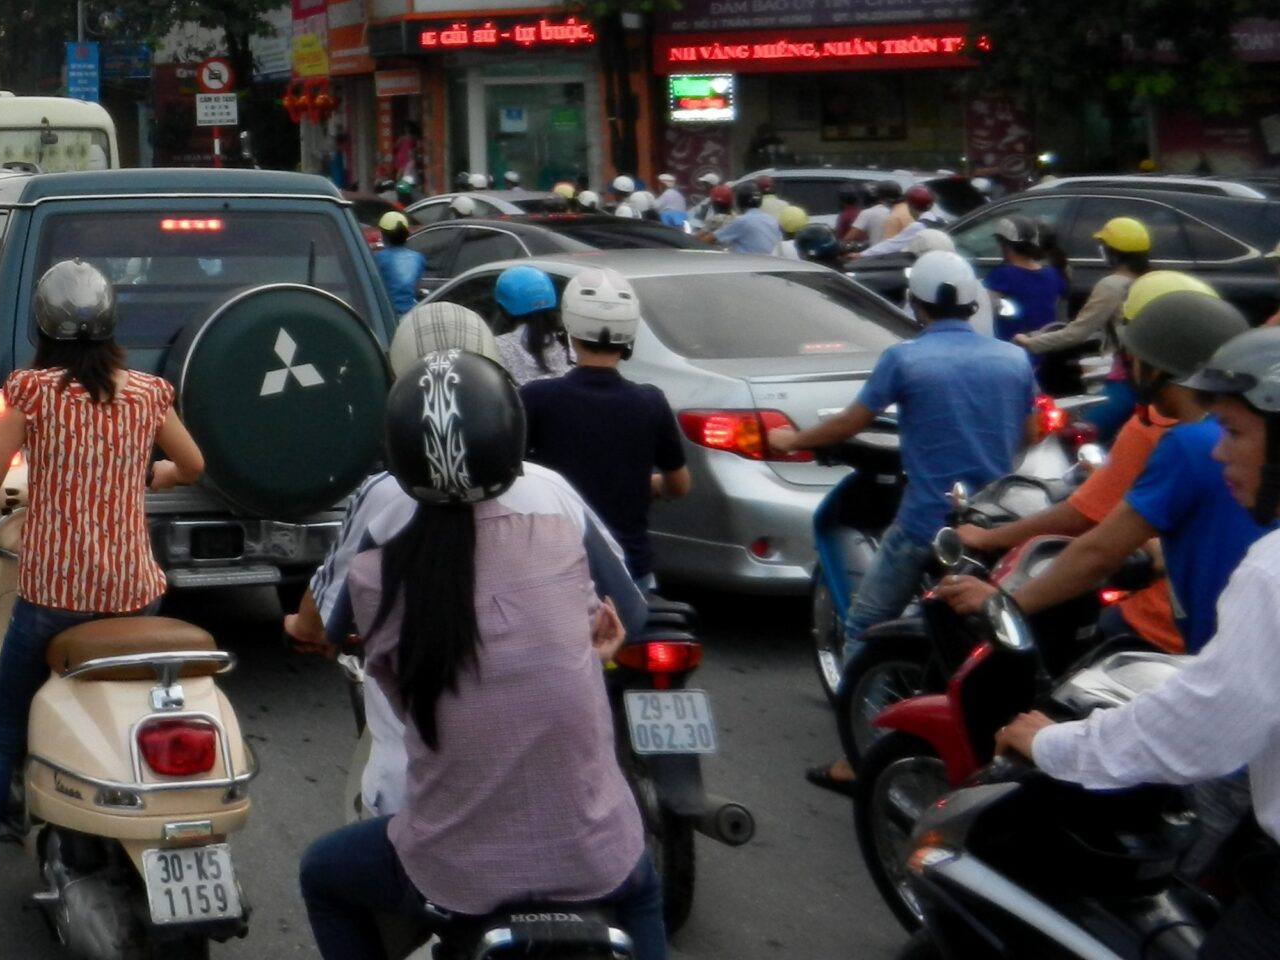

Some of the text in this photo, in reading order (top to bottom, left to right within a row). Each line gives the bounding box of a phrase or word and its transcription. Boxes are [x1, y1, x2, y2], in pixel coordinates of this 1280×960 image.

[636, 722, 712, 749] 062.30
[157, 850, 223, 884] 30-K5
[163, 882, 229, 918] 1159
[510, 912, 584, 923] HONDA
